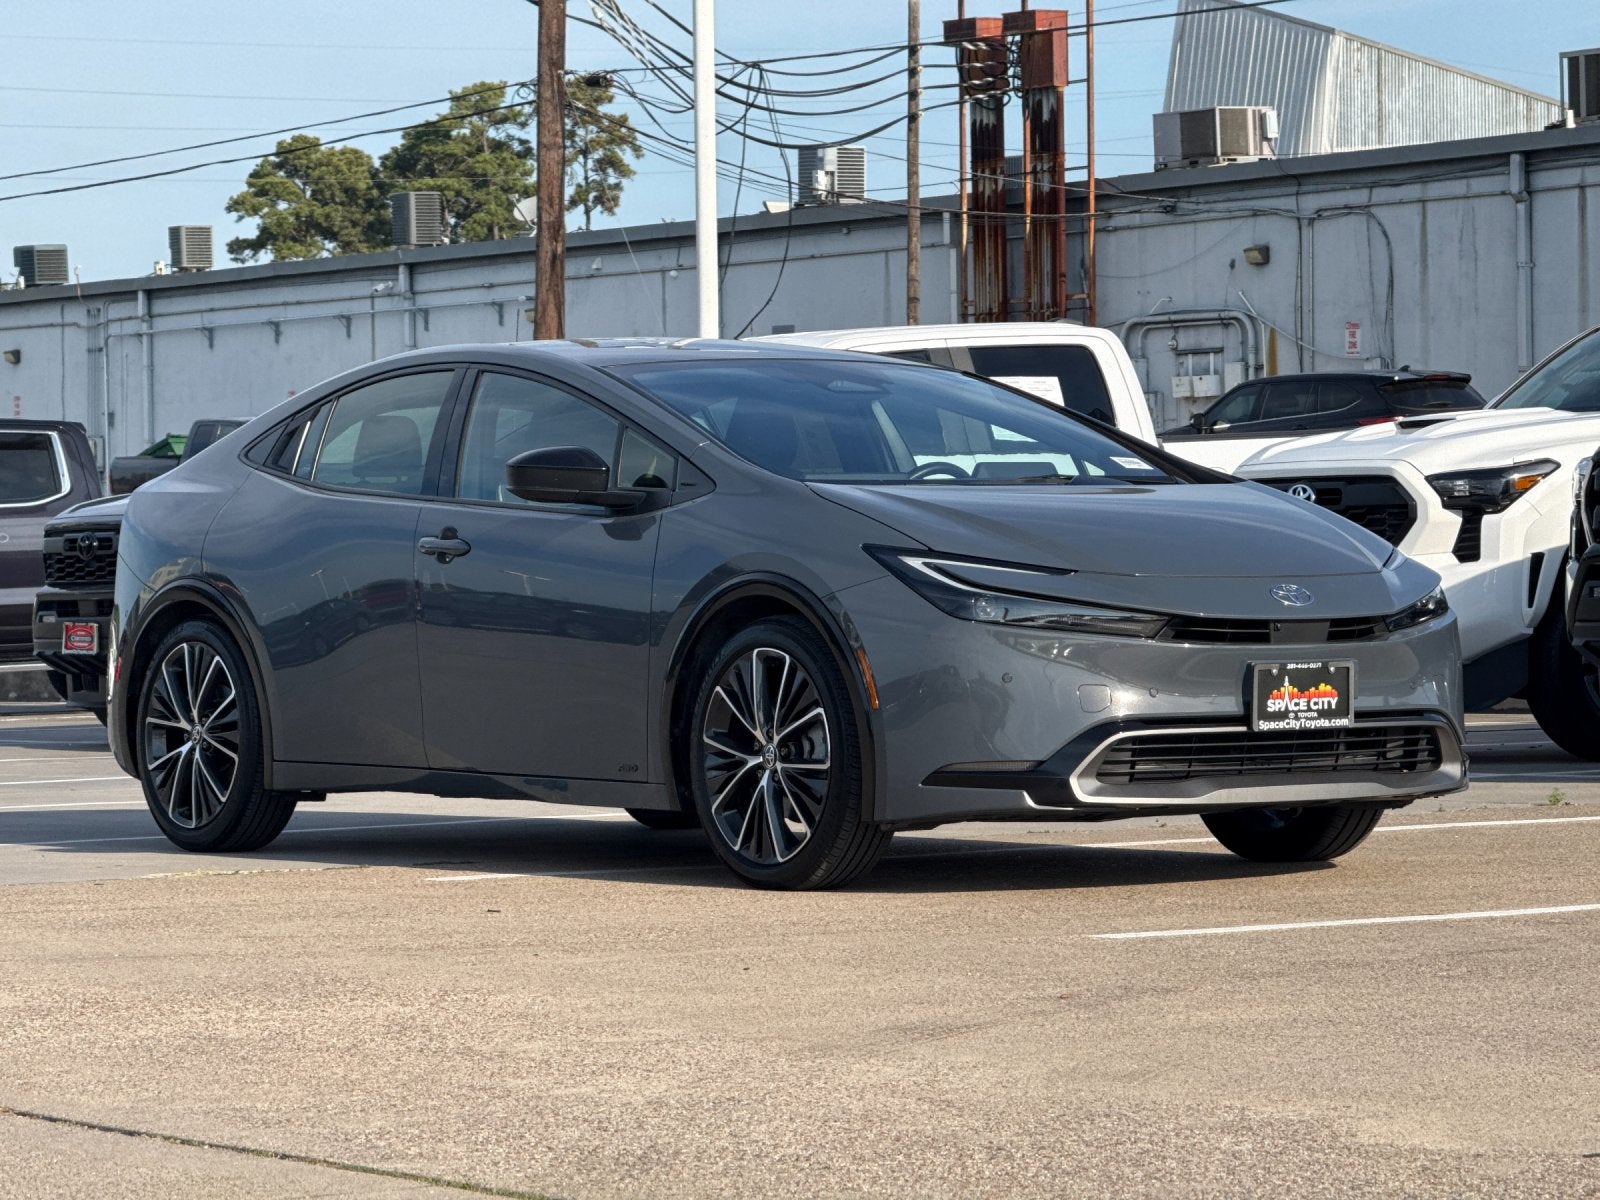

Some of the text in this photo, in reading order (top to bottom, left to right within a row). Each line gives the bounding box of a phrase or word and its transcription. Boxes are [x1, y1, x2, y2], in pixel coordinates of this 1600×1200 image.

[1267, 697, 1338, 712] SPACE CITY
[1258, 718, 1349, 731] SpaceCityToyota.com
